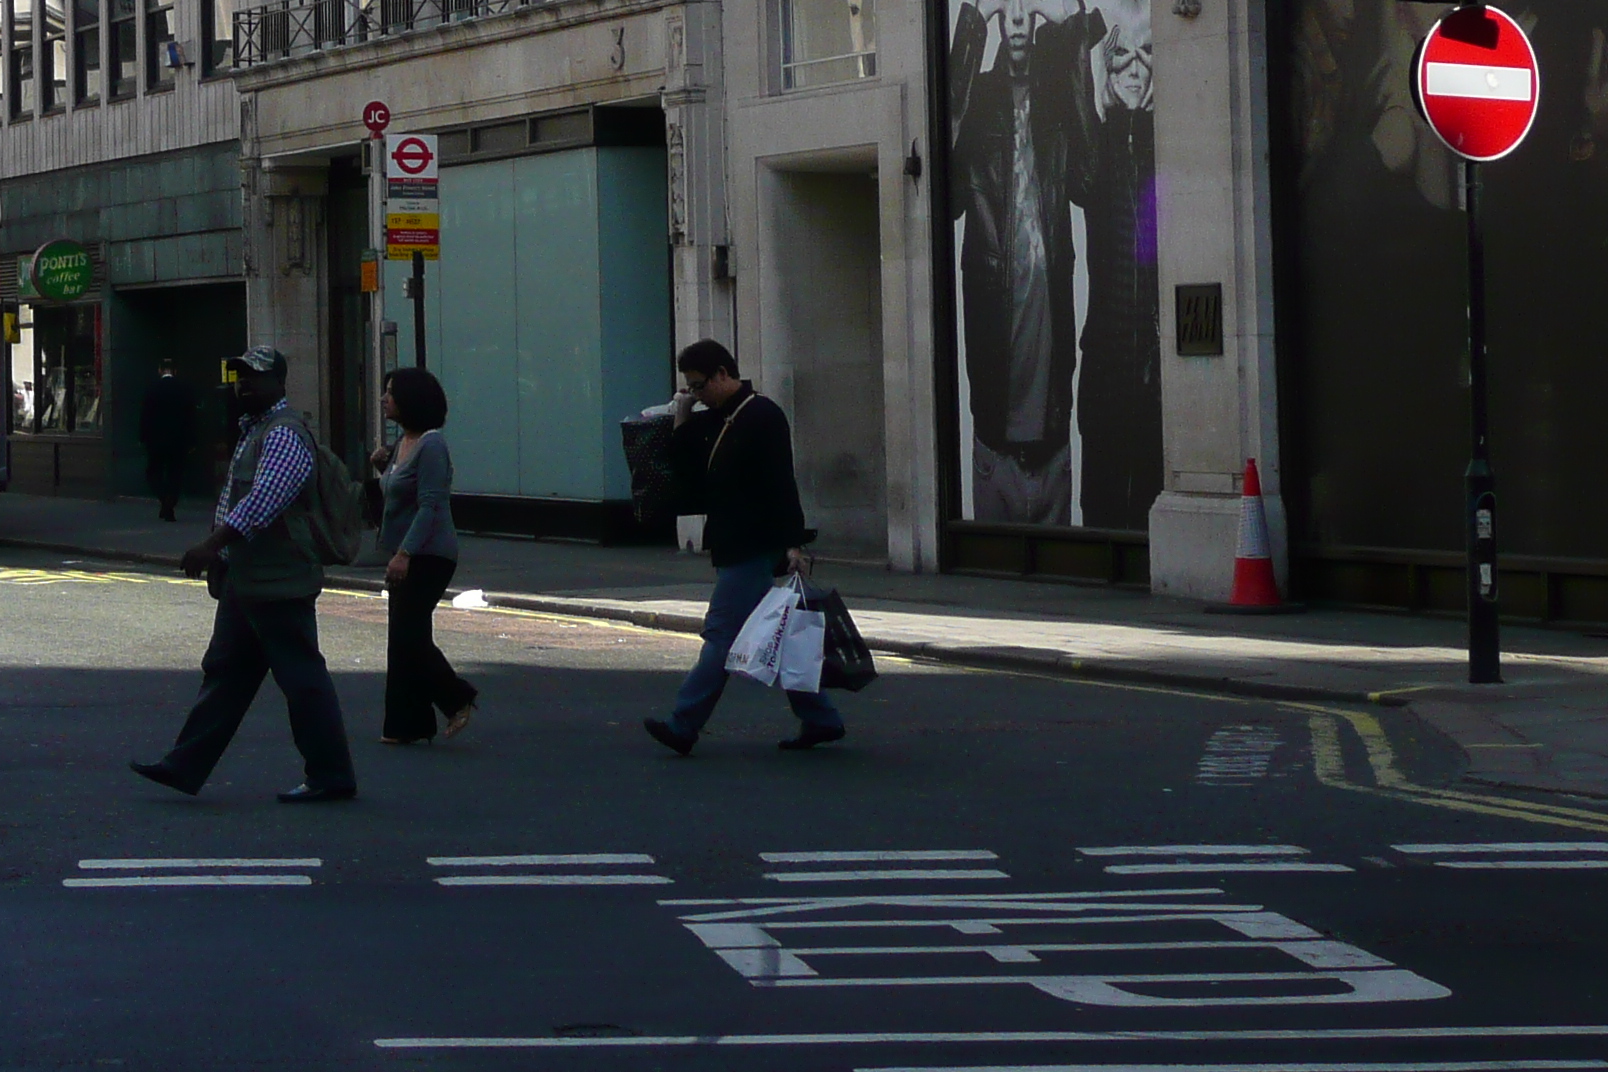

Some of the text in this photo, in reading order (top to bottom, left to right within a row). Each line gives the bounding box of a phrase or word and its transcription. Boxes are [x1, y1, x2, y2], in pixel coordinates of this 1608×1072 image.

[368, 110, 385, 123] JC
[46, 272, 80, 285] coffee
[63, 284, 82, 295] bar
